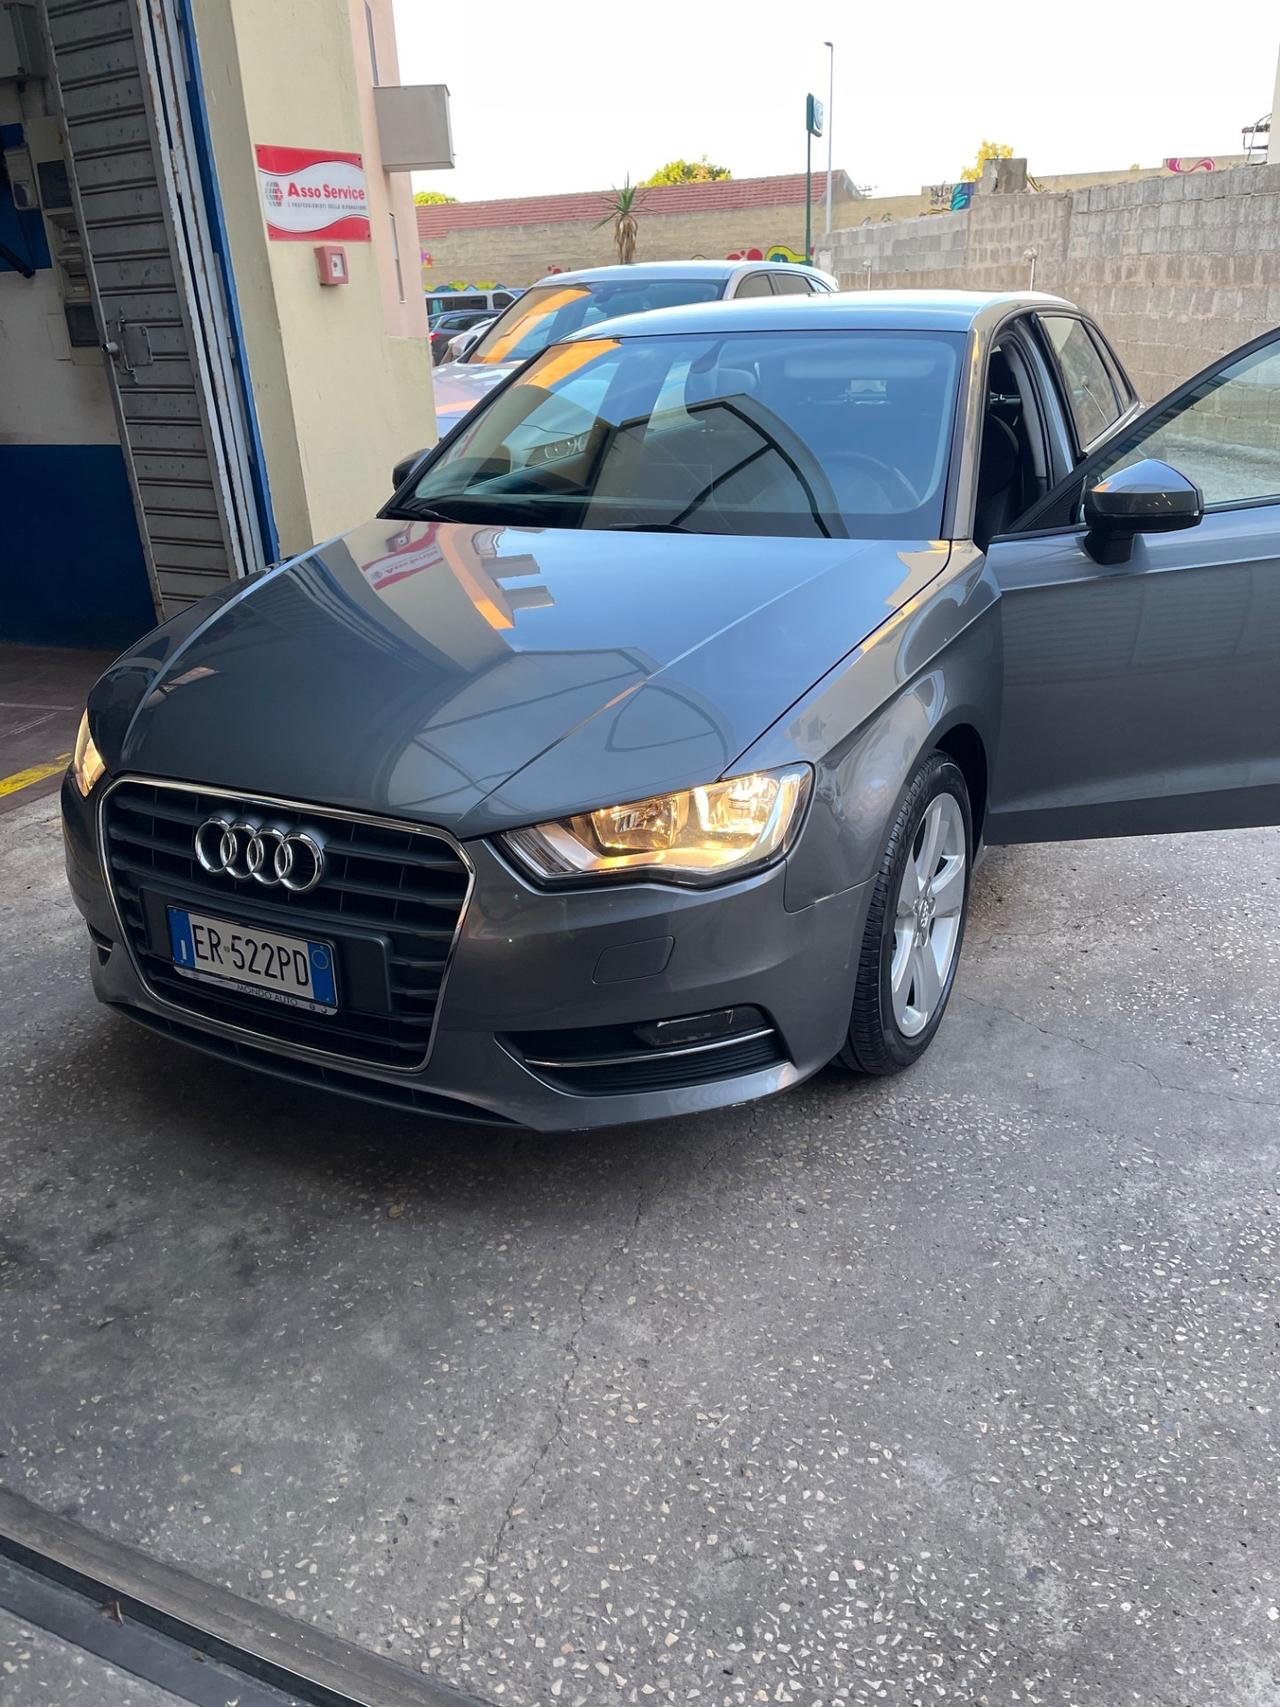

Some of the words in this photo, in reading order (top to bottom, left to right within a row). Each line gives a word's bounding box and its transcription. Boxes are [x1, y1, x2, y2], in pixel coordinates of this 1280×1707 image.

[287, 182, 321, 198] Asso
[323, 184, 365, 200] Service
[236, 983, 273, 999] MONDO
[275, 993, 299, 1007] AUTO
